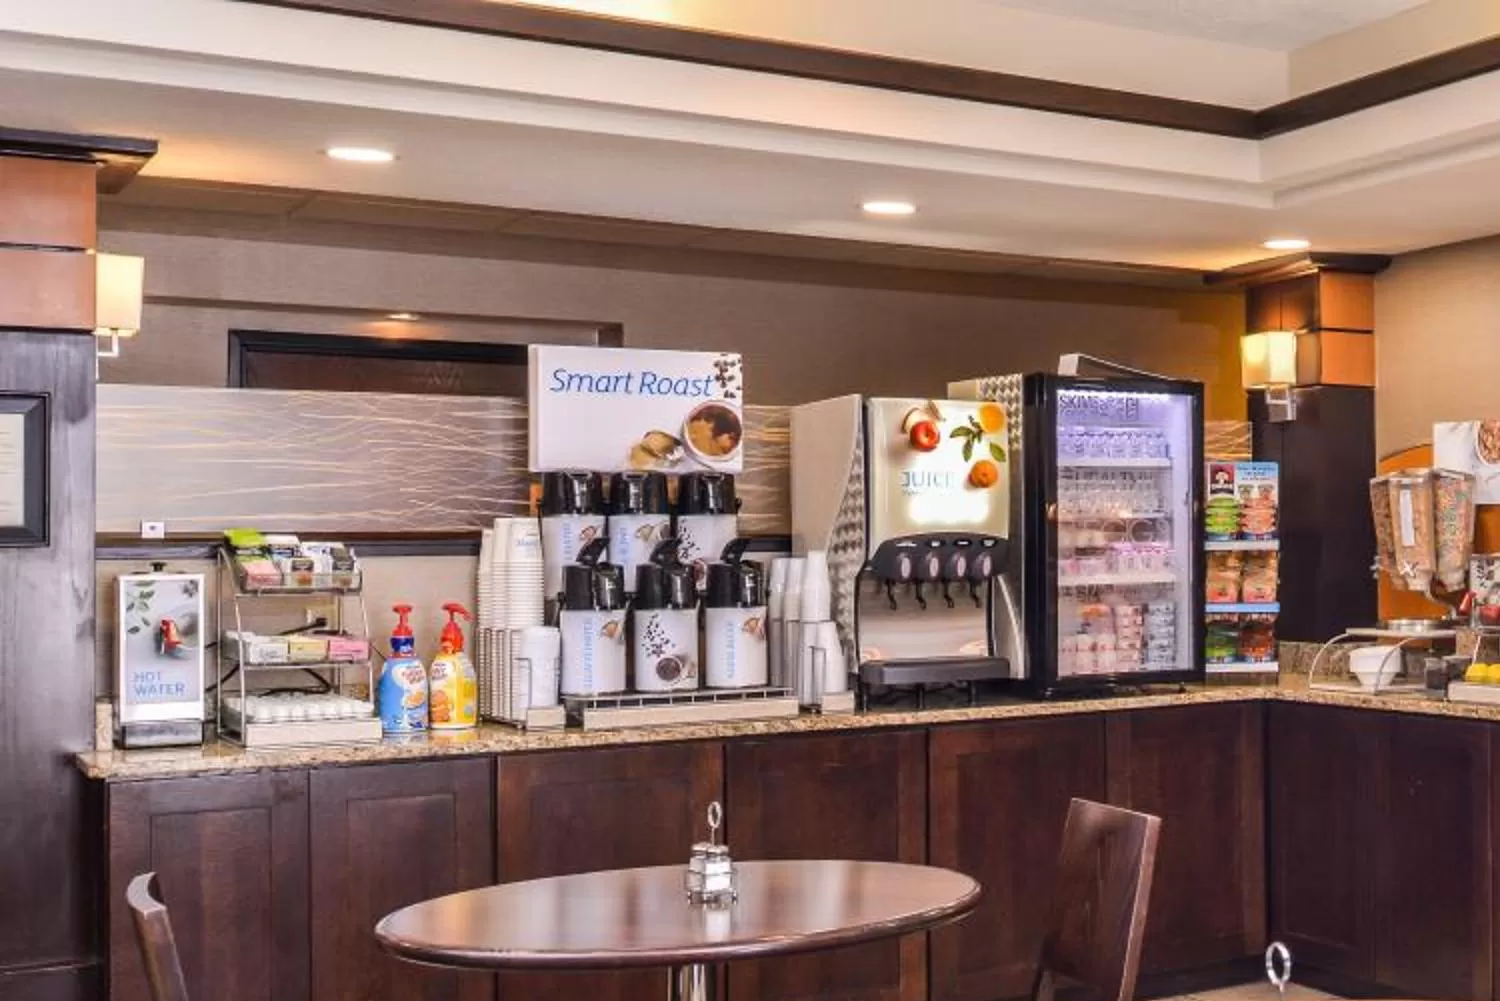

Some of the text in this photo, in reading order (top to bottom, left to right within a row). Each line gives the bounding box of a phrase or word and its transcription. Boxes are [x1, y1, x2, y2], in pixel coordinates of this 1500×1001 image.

[550, 368, 714, 397] Smart Roast
[135, 683, 186, 697] WATER
